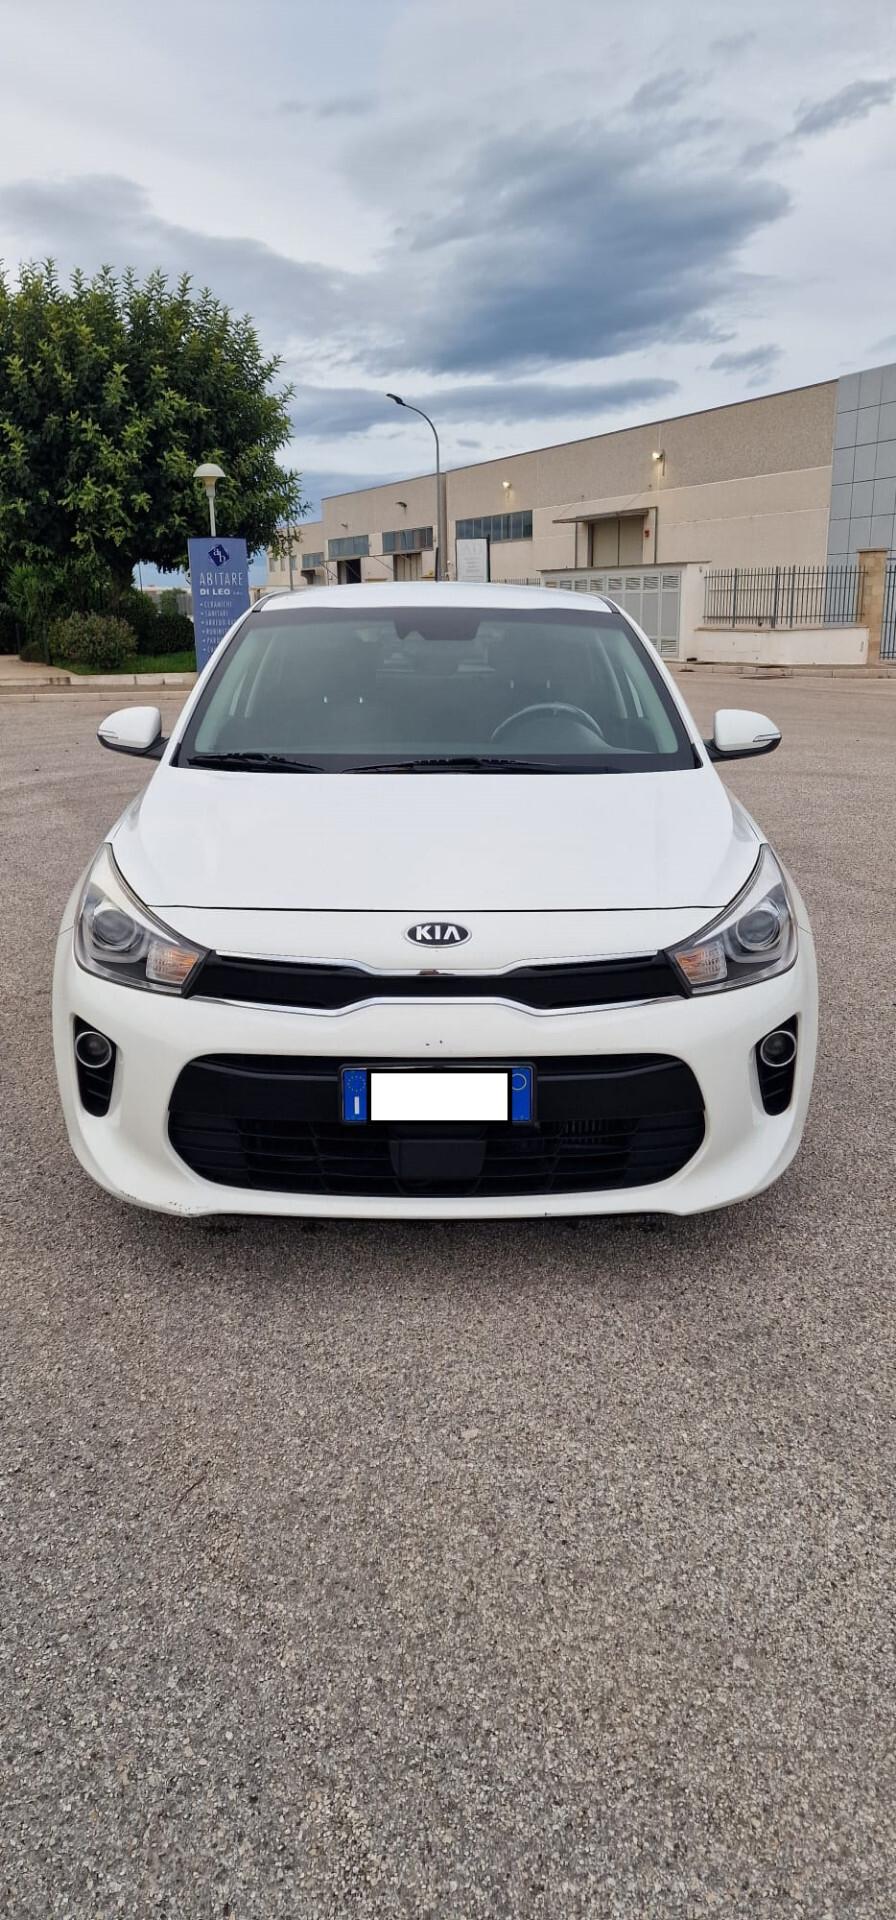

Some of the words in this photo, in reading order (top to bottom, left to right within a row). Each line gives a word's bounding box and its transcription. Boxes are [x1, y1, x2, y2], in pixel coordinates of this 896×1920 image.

[199, 572, 243, 586] ABITARE
[199, 588, 210, 596] DI
[212, 588, 231, 596] LEO
[416, 924, 461, 941] KIA
